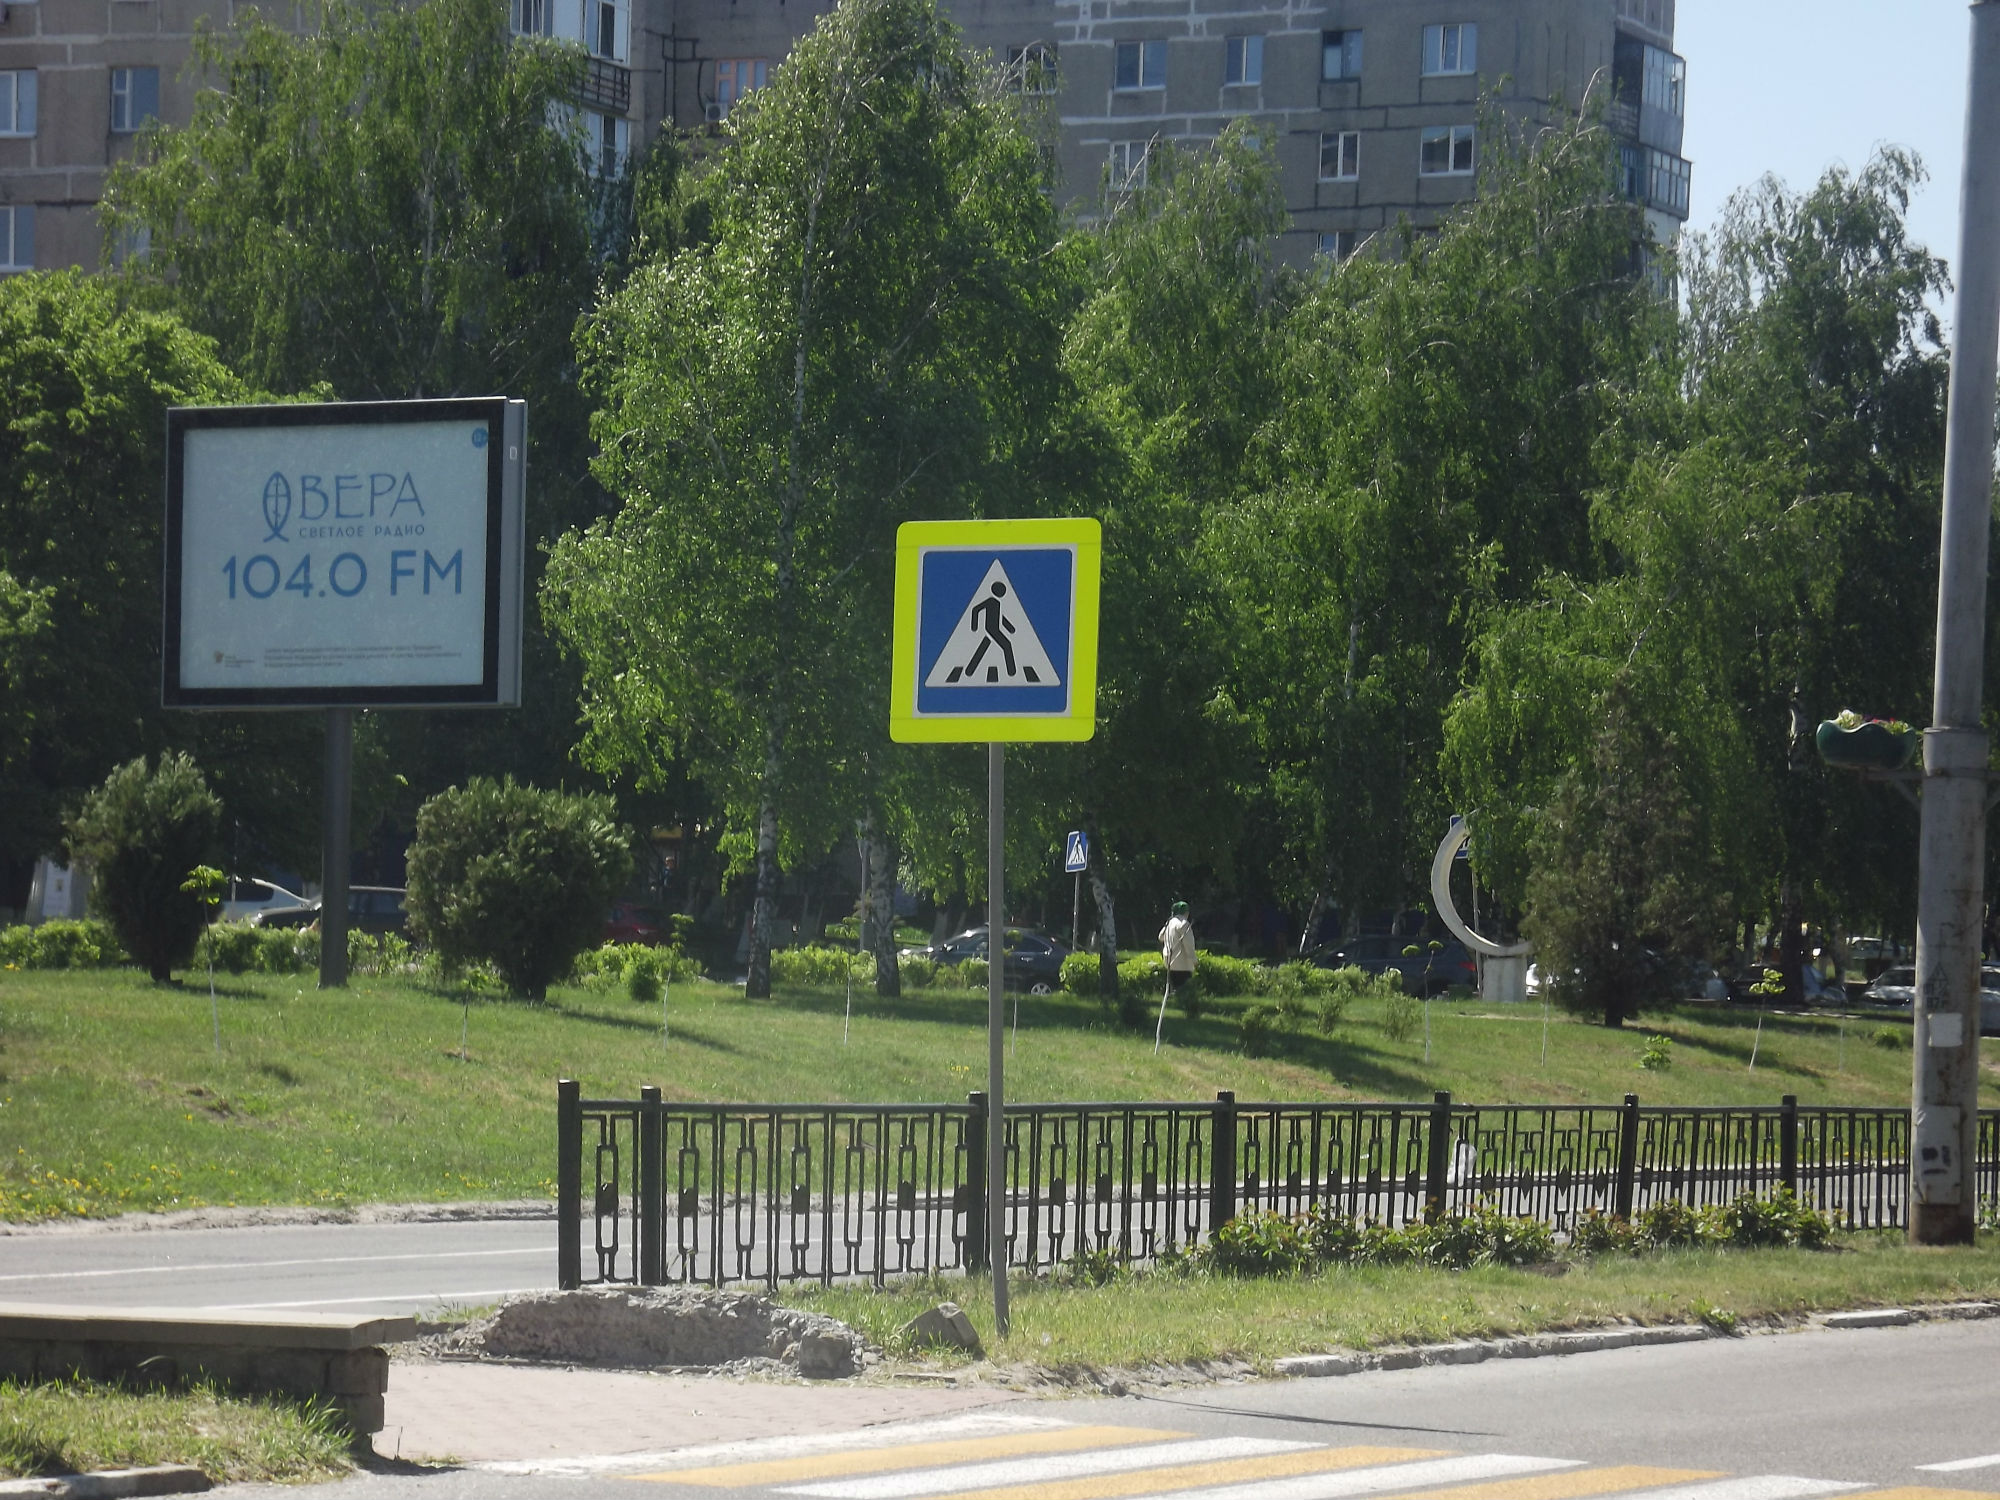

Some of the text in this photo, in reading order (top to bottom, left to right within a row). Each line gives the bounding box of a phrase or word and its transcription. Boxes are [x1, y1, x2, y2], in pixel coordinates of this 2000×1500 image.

[299, 471, 425, 520] ВЕРА
[299, 523, 425, 539] СВЕТЛОЕ РАДИО
[222, 548, 463, 600] 104.0 FM
